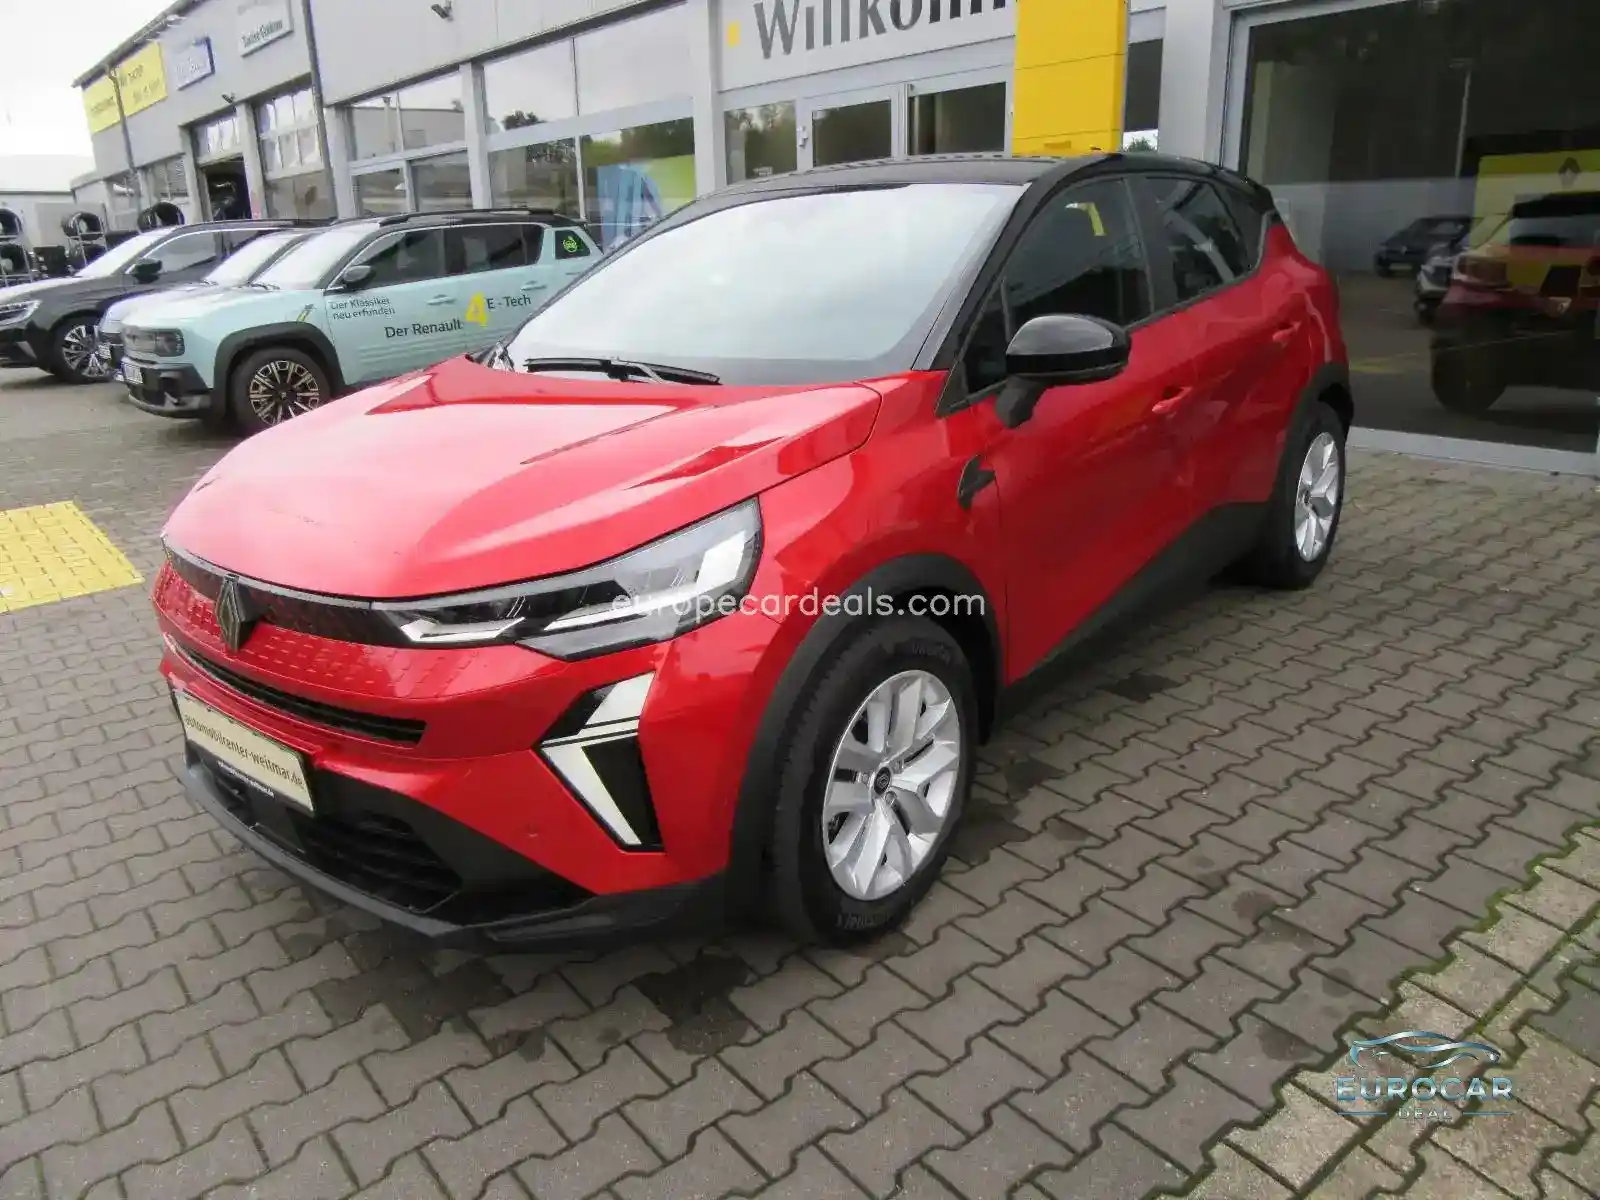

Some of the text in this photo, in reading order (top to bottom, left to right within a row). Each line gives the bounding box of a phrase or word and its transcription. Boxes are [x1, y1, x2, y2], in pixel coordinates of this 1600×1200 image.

[754, 0, 1006, 59] Willko
[333, 306, 396, 320] neu erfunden
[384, 325, 410, 339] Der
[412, 317, 464, 336] Renault
[465, 292, 487, 328] 4
